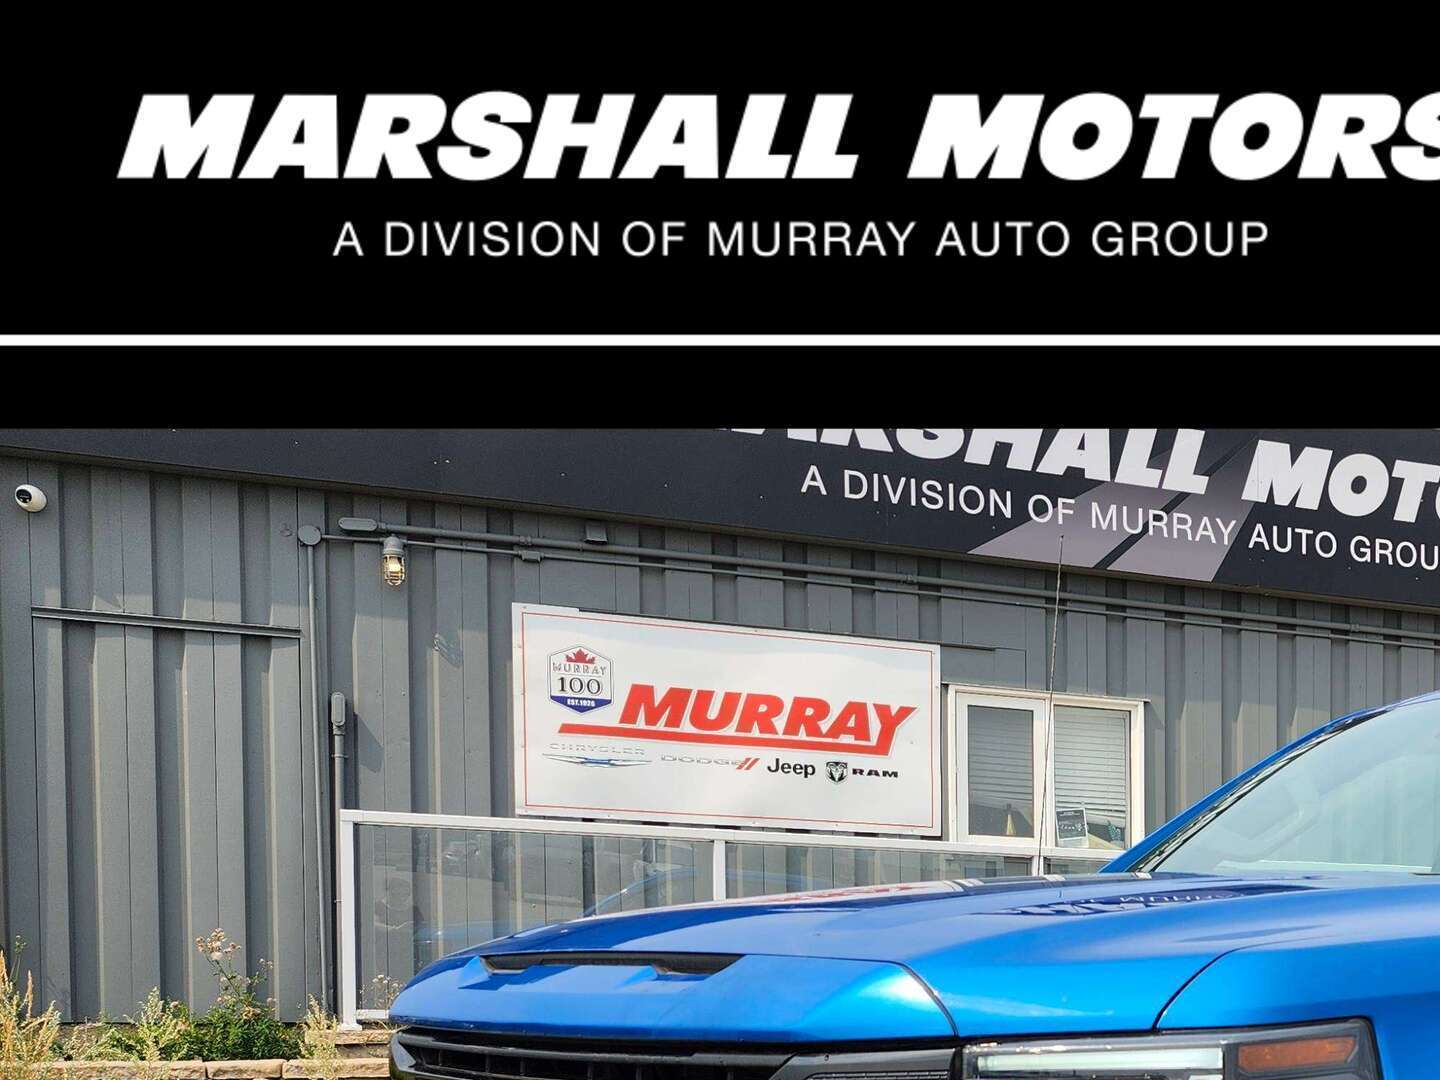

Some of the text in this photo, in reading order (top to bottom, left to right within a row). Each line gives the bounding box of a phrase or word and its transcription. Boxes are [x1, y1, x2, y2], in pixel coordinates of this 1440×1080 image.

[801, 466, 827, 495] A
[844, 470, 1012, 519] DIVISION
[1028, 495, 1076, 525] OF
[1091, 502, 1237, 546] MURRAY
[1248, 524, 1337, 558] AUTO
[552, 662, 607, 675] MURRAY
[557, 676, 602, 695] 100
[619, 683, 918, 755] MURRAY
[767, 758, 816, 778] Jeep
[852, 768, 899, 778] RAM
